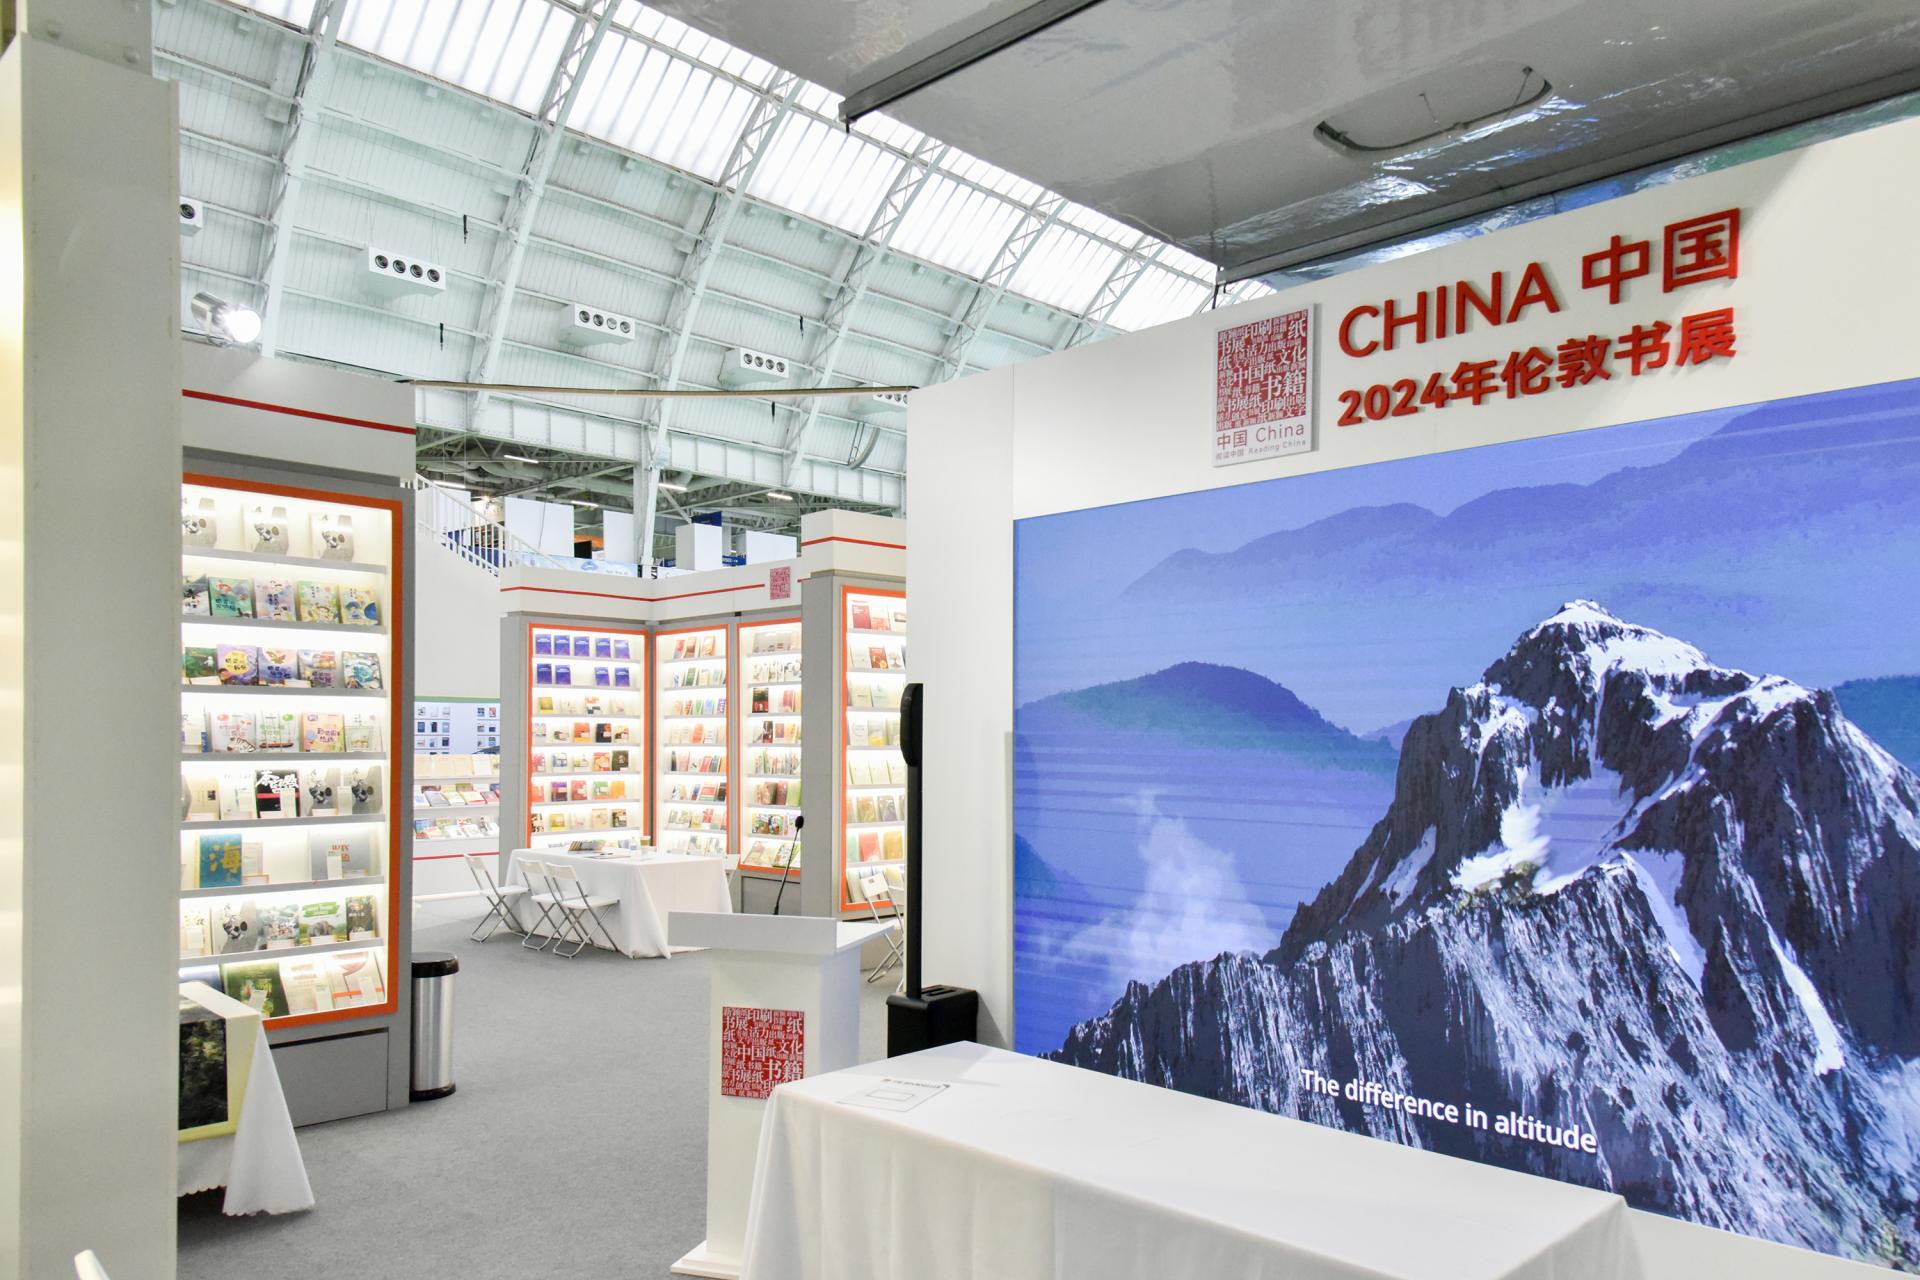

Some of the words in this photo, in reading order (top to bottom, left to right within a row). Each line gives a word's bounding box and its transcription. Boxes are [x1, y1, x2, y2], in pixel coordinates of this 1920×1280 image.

[1338, 262, 1560, 358] CHINA
[1581, 208, 1740, 304] 中国
[1245, 317, 1272, 340] 印刷
[1288, 320, 1306, 339] 纸
[1278, 346, 1306, 365] 文化
[1234, 364, 1264, 386] 中国
[1337, 308, 1737, 426] 2024年伦敦书展
[1262, 370, 1305, 400] 书籍
[1217, 429, 1247, 450] 中国
[1256, 423, 1304, 442] China
[1248, 443, 1280, 455] Reading
[1282, 439, 1306, 449] China
[723, 1016, 748, 1031] 书展
[748, 1009, 772, 1024] 印刷
[787, 1018, 803, 1034] 纸
[737, 1042, 765, 1062] 中国
[778, 1037, 803, 1055] 文化
[764, 1059, 803, 1082] 书籍
[1300, 1068, 1340, 1097] The
[1345, 1078, 1459, 1123] difference
[1465, 1103, 1488, 1130] in
[1495, 1111, 1597, 1154] altitude
